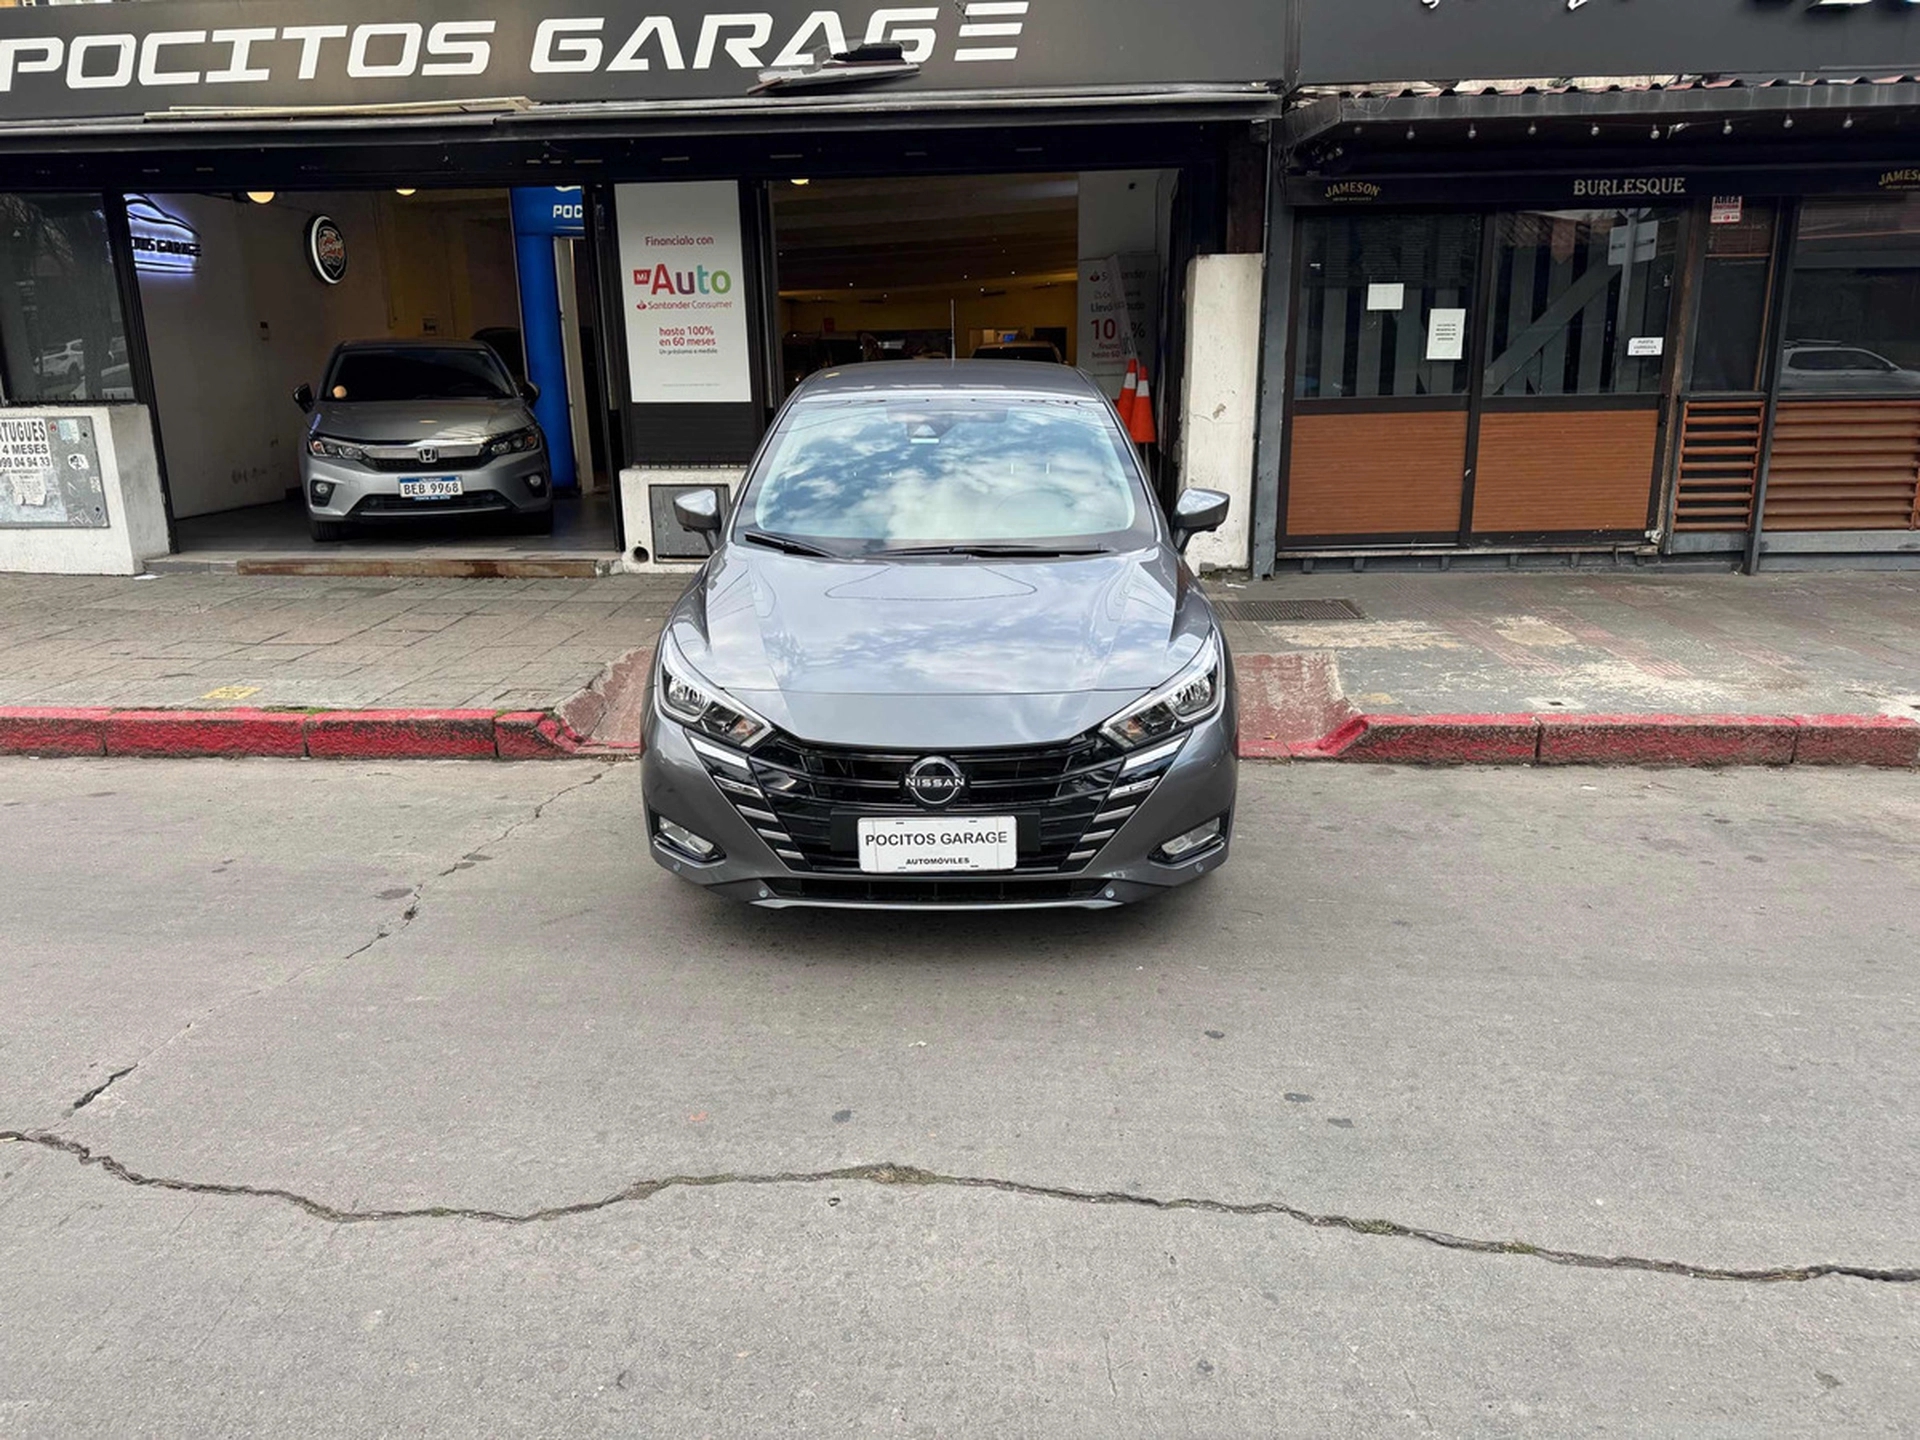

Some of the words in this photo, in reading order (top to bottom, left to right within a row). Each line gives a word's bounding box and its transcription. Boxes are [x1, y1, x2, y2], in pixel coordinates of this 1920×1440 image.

[0, 20, 497, 92] POCITOS
[530, 2, 1030, 74] GARAGE
[1878, 169, 1920, 186] JAMES
[1325, 181, 1379, 198] JAMESON
[1573, 177, 1686, 196] BURLESQUE
[696, 236, 714, 246] con
[651, 263, 732, 295] Auto
[647, 301, 691, 310] Santander
[691, 300, 733, 309] Consumer
[659, 327, 685, 336] hasta
[687, 325, 715, 335] 100%
[659, 338, 671, 346] en
[672, 336, 685, 346] 60
[686, 338, 716, 346] meses
[2, 444, 9, 455] 4
[11, 444, 49, 455] MESES
[0, 457, 12, 467] 99
[14, 457, 25, 467] 04
[404, 483, 426, 495] BEB
[430, 482, 459, 493] 9968
[905, 778, 965, 788] NISSAN
[865, 833, 936, 846] POCITOS
[940, 831, 1008, 845] GARAGE
[906, 856, 970, 866] AUTOMÓVILES
